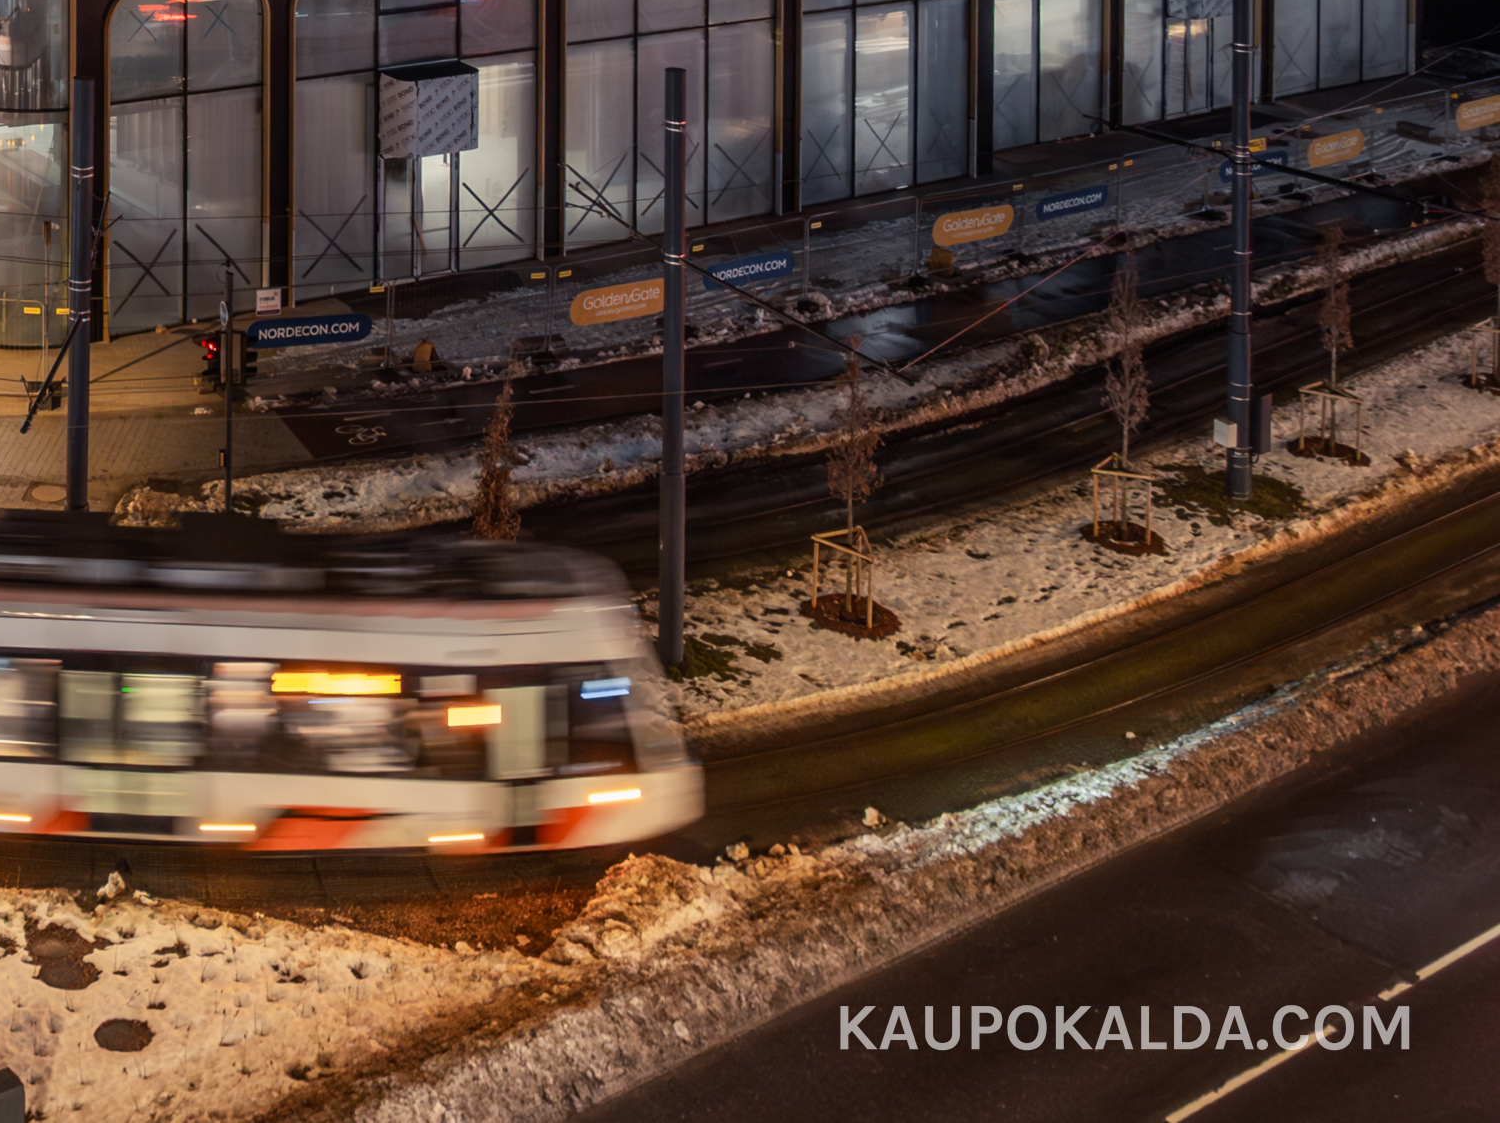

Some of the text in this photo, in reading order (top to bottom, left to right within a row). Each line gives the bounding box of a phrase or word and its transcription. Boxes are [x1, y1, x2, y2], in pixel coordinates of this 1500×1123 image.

[1043, 191, 1103, 214] NORDECON.COM
[712, 258, 787, 281] NORDECON.COM
[258, 322, 360, 341] NORDECON.COM
